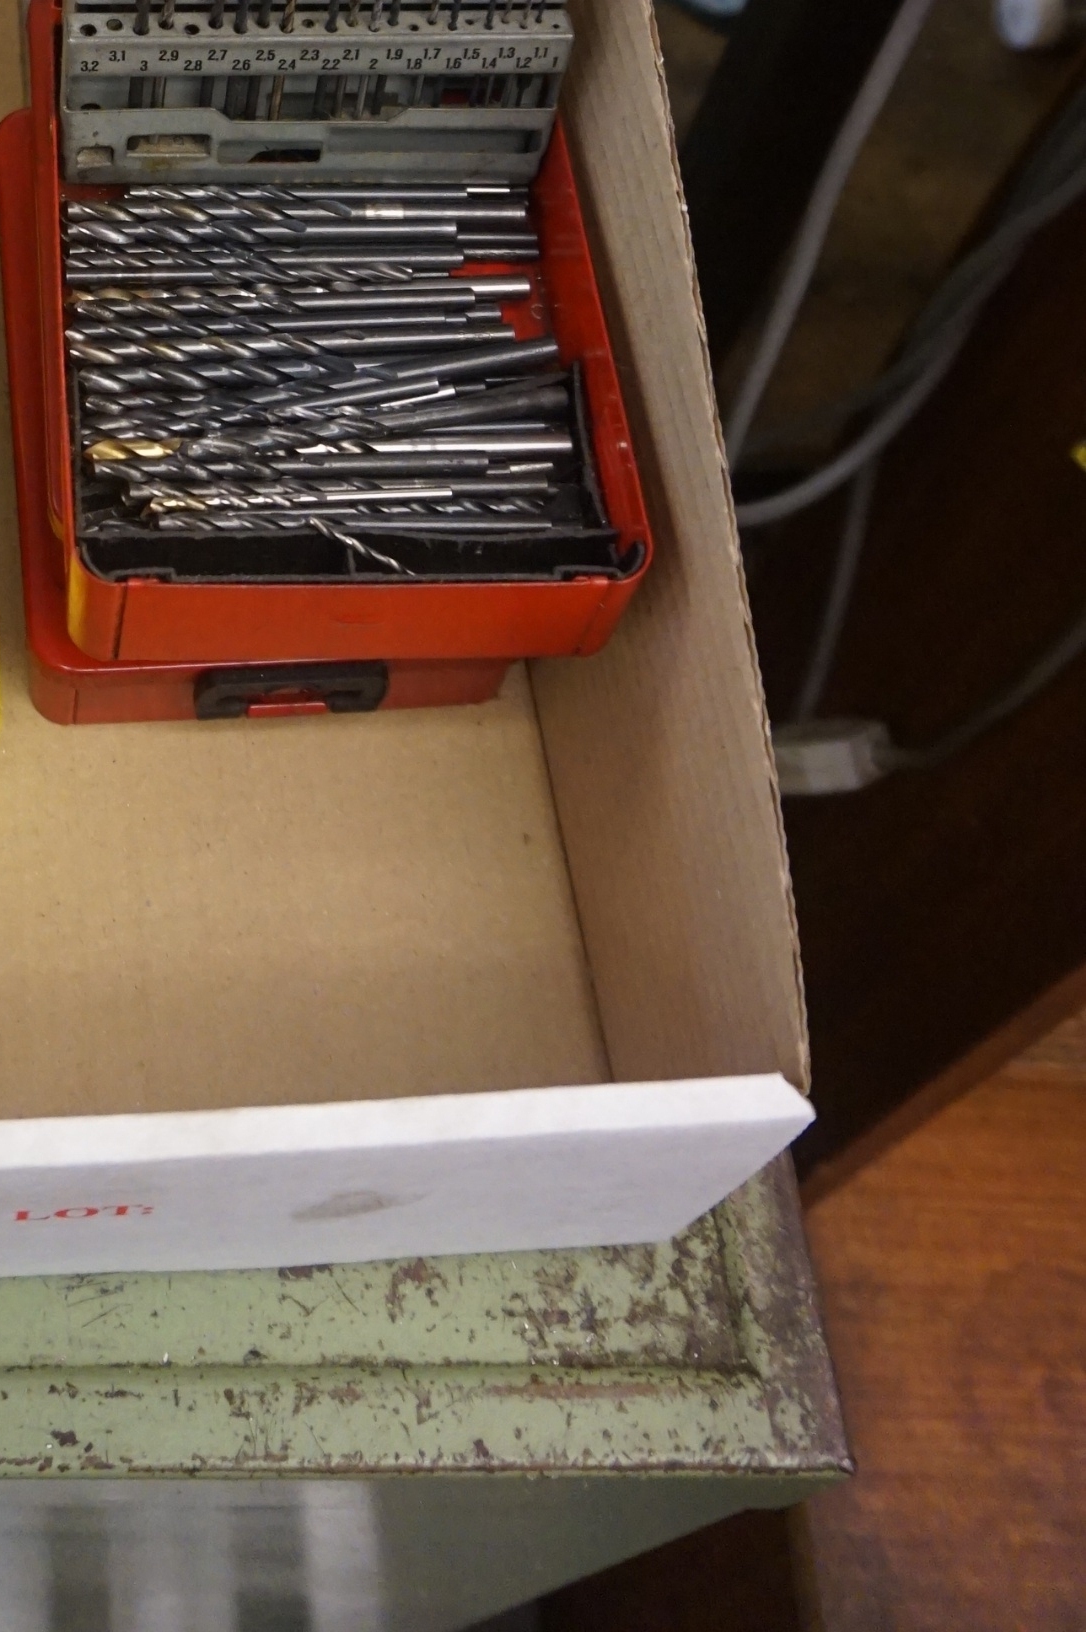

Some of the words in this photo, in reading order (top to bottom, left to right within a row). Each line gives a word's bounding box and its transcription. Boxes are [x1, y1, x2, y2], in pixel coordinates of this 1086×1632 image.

[139, 60, 148, 71] 3
[369, 58, 379, 70] 2
[552, 56, 559, 68] 1
[14, 1204, 154, 1221] LOT:
